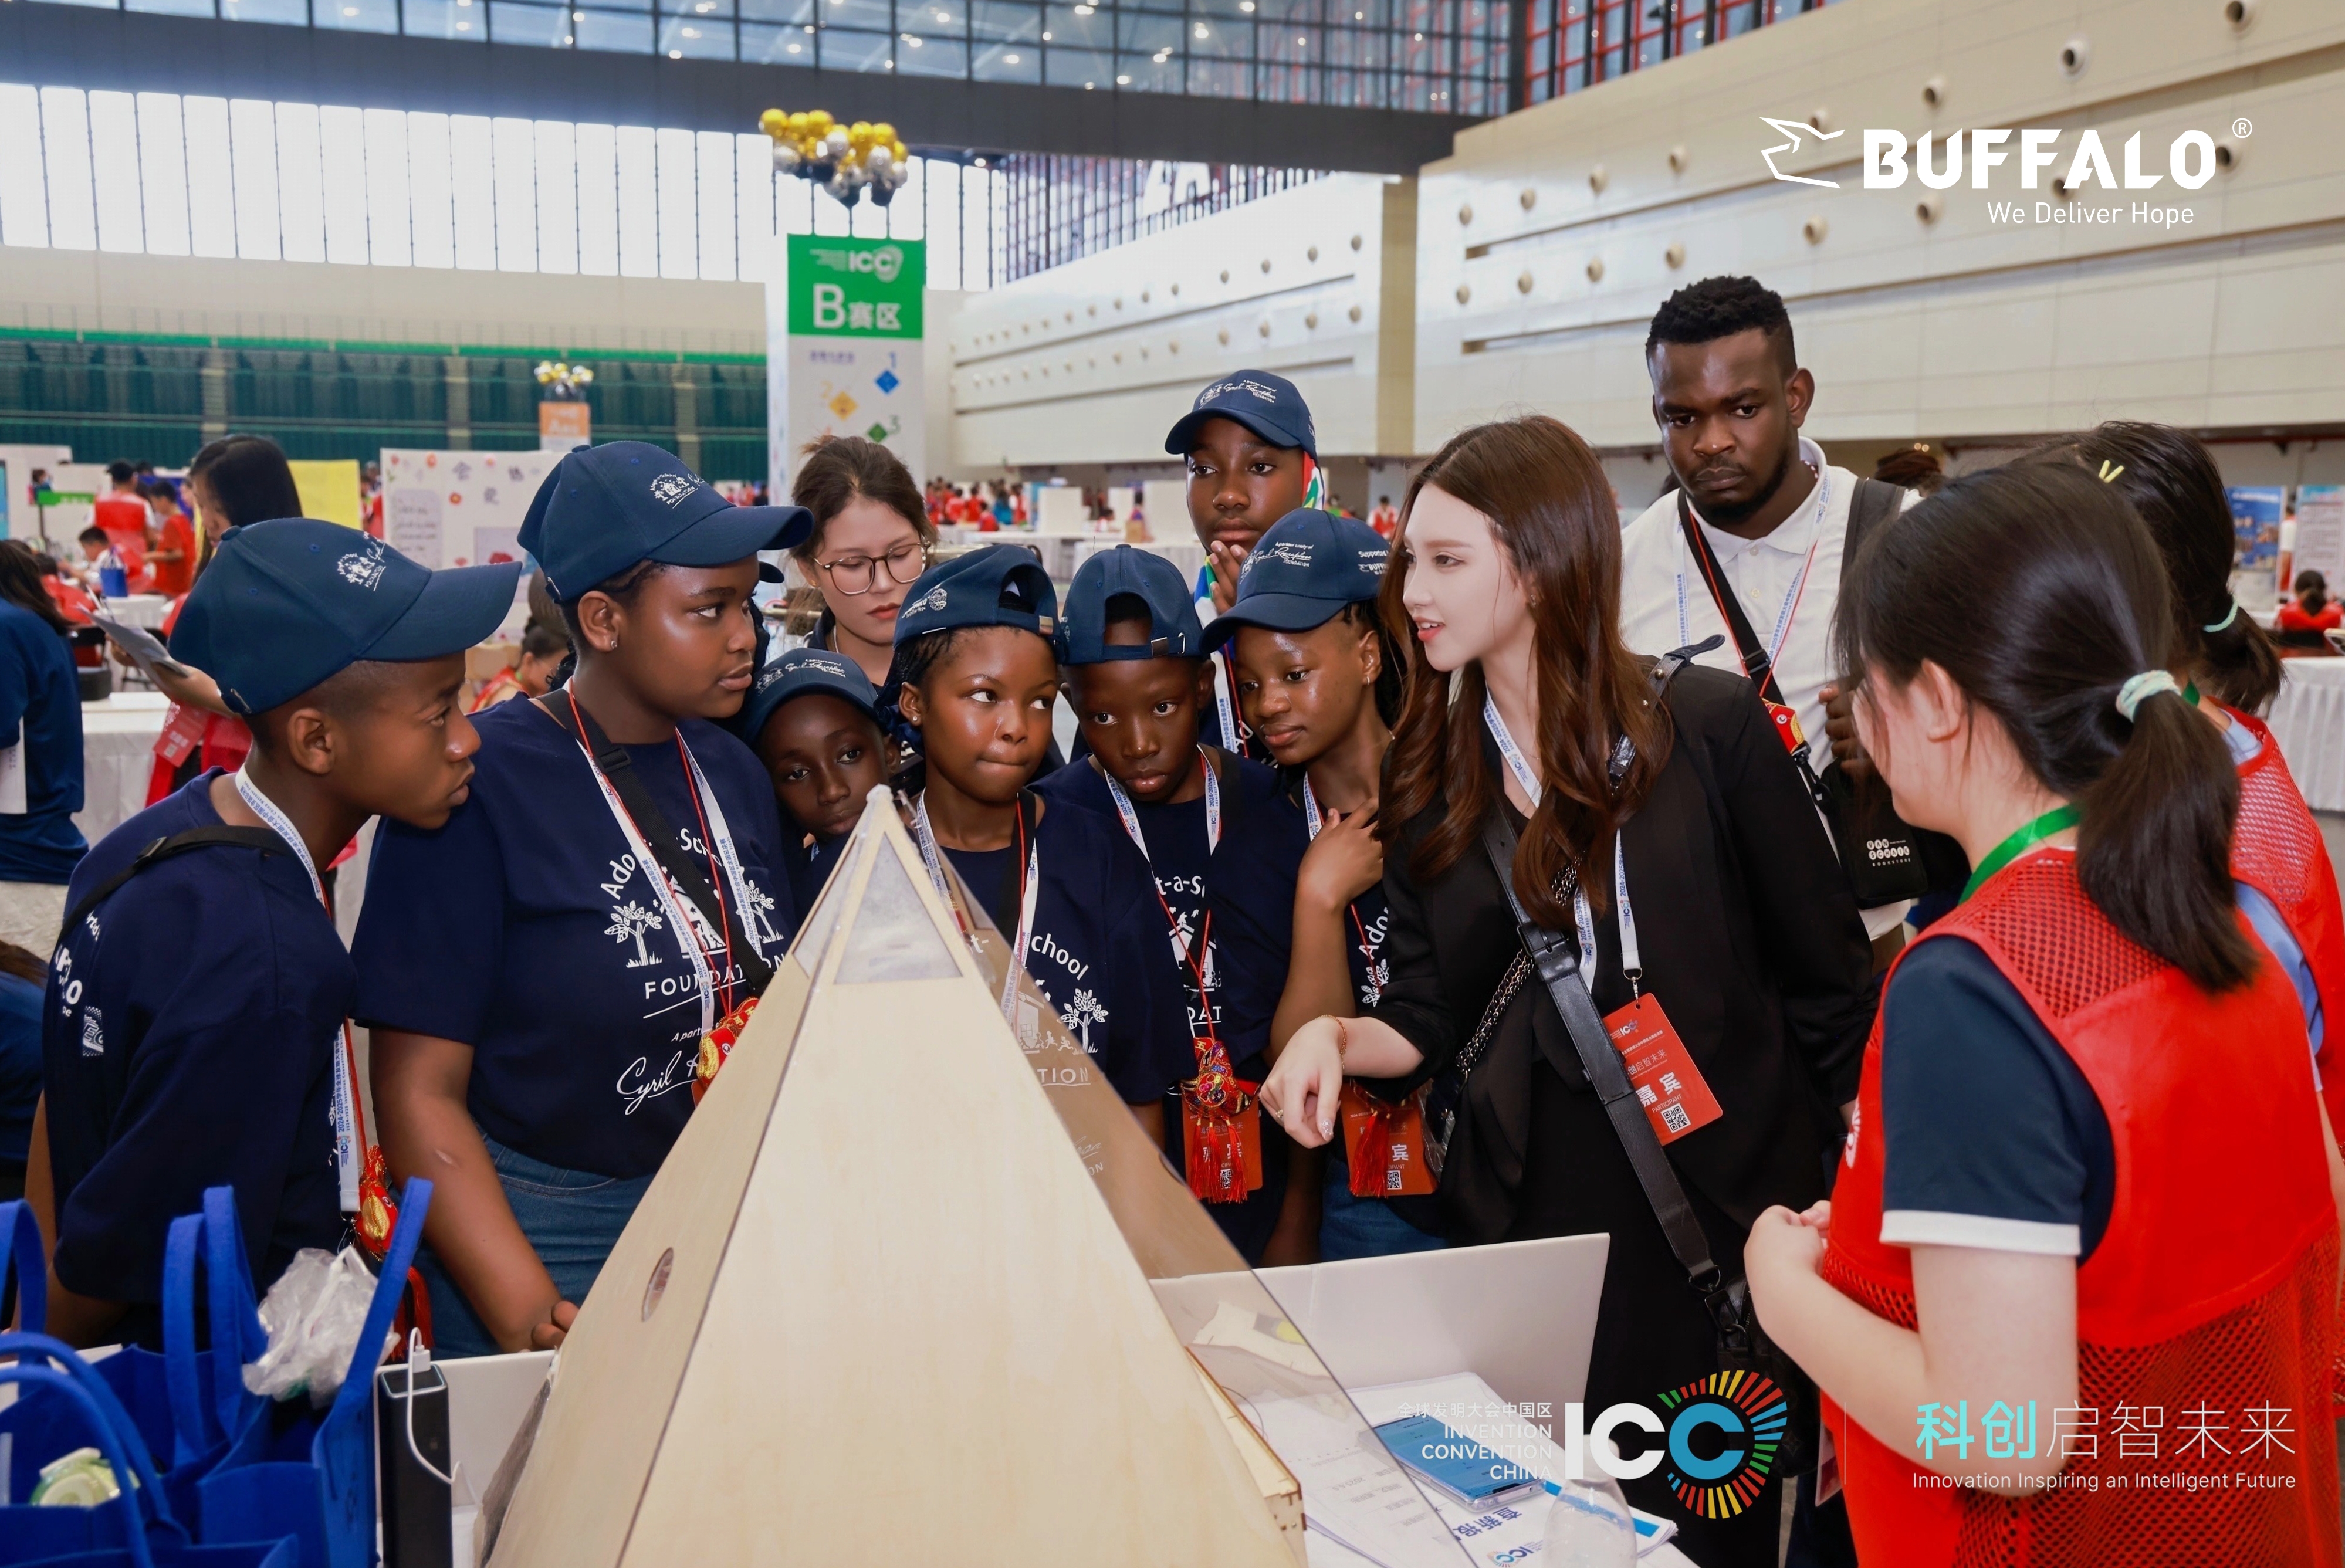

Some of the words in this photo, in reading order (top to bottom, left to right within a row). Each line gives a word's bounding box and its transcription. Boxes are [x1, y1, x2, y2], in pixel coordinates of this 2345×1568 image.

[848, 250, 891, 272] ICC
[813, 283, 902, 331] B赛区
[1866, 838, 1889, 850] VAN
[1868, 845, 1910, 861] SCHAIK
[1872, 858, 1911, 867] BOOKSTORE
[1620, 1021, 1637, 1037] ICC
[1627, 1048, 1667, 1076] 创启智未来
[616, 1050, 682, 1116] Cyril
[1659, 1071, 1682, 1096] 宾
[1651, 1093, 1683, 1114] PARTICIPANT
[340, 1138, 348, 1154] ICC
[1392, 1144, 1409, 1161] 宾
[1454, 1506, 1522, 1541] 查新报
